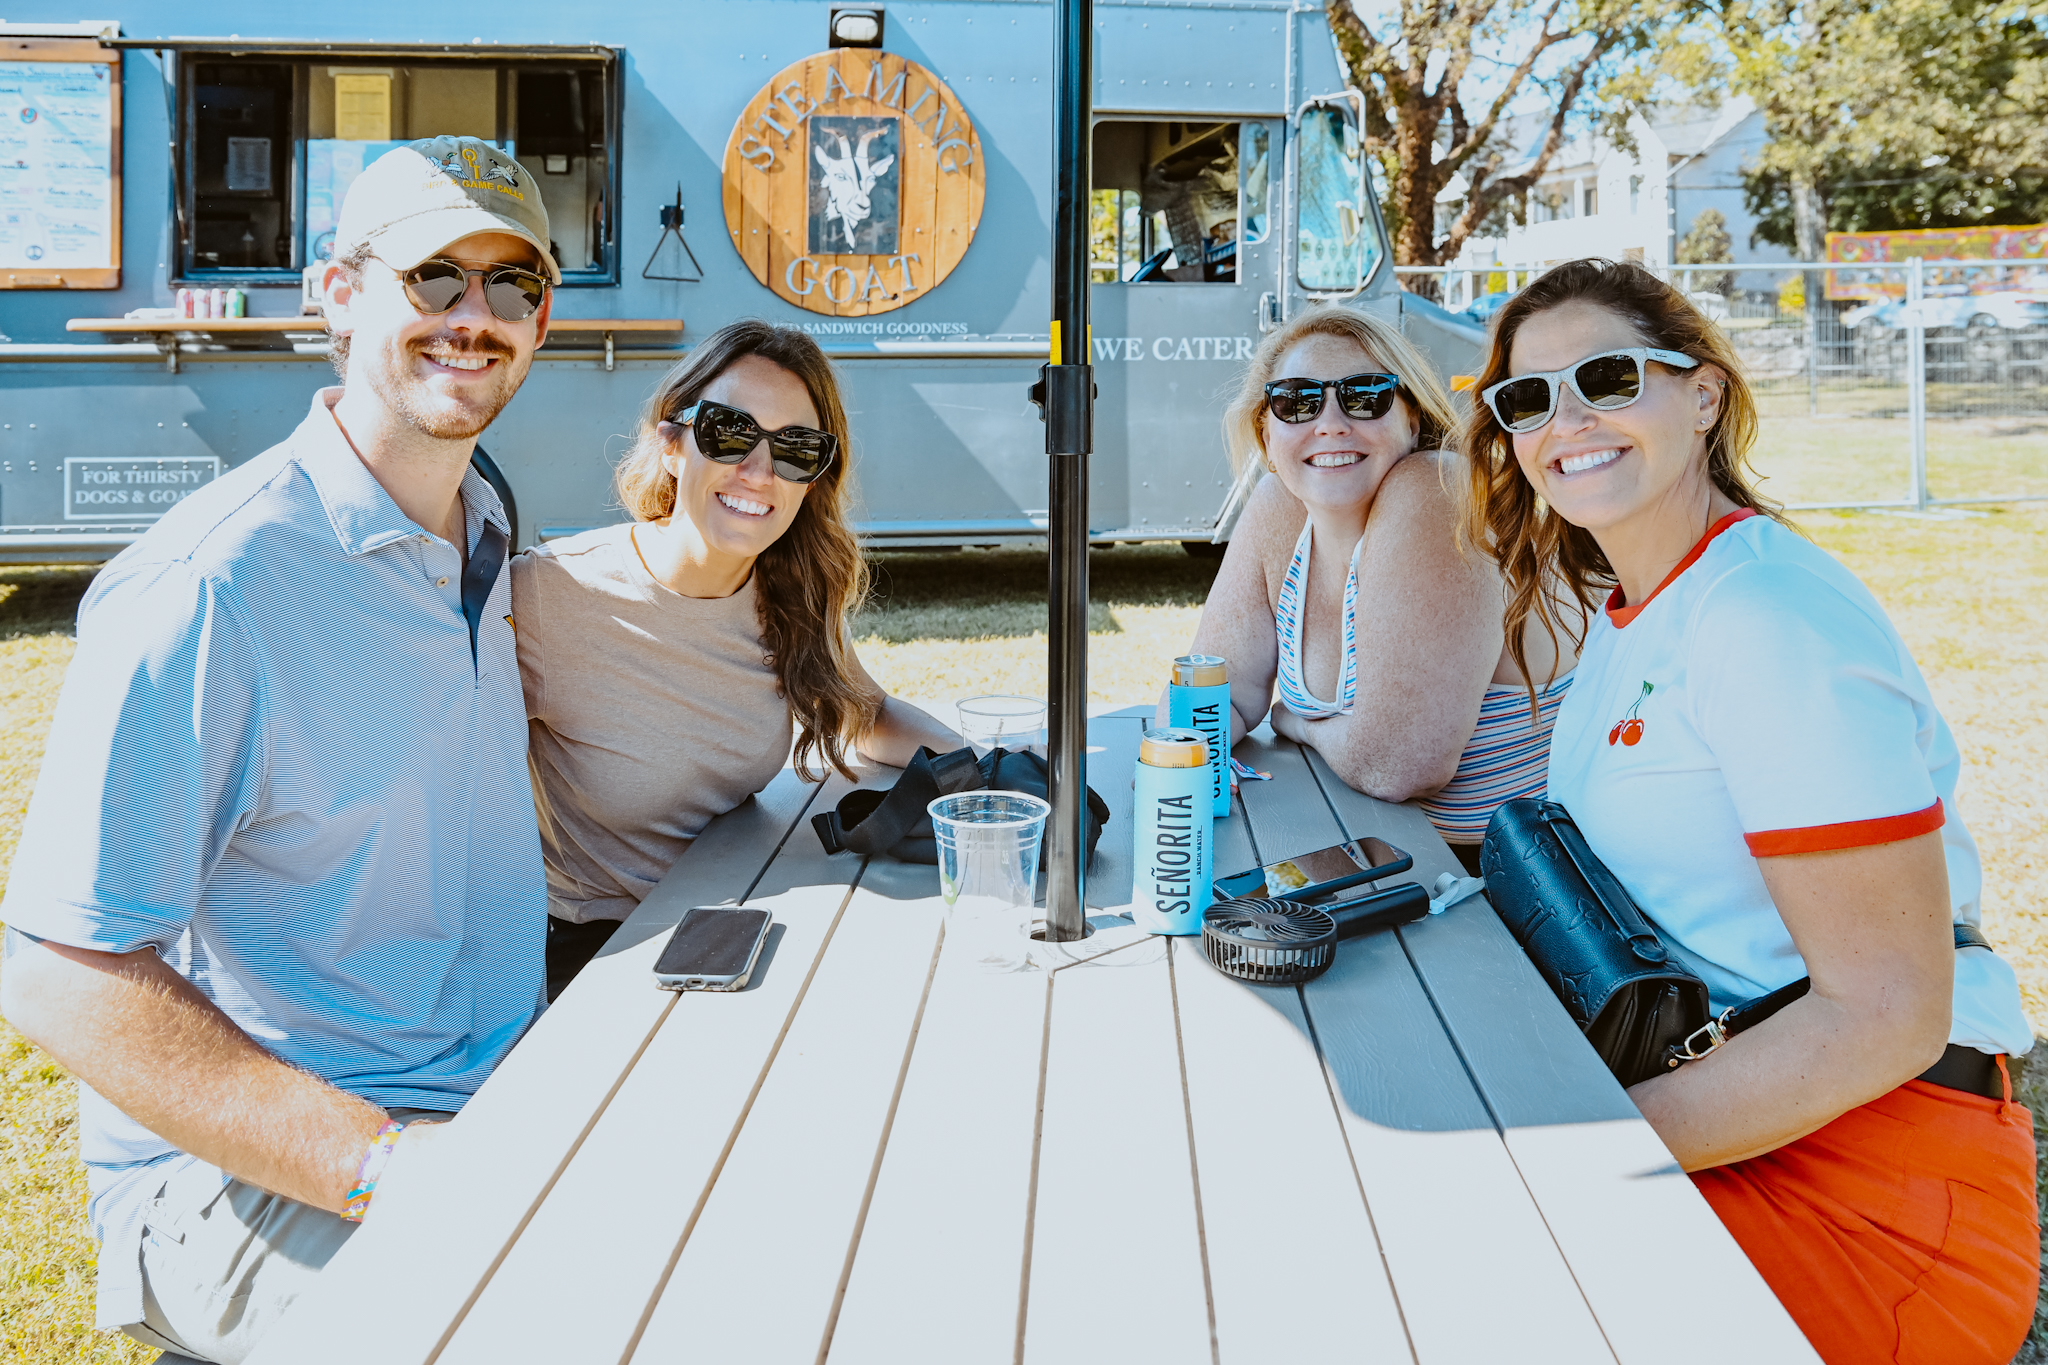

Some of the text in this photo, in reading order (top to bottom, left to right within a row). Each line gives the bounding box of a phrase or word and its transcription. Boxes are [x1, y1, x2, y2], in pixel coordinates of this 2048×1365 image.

[739, 60, 974, 174] STEAMING
[462, 180, 495, 190] GAME
[497, 184, 524, 201] CALLS
[785, 253, 920, 304] GOAT
[803, 322, 882, 335] SANDWICH
[886, 322, 968, 335] GOODNESS
[1092, 336, 1254, 361] WE CATER
[82, 470, 203, 485] FOR THIRSTY
[74, 489, 194, 505] DOGS & GOA
[1151, 794, 1193, 915] SEÑORITA
